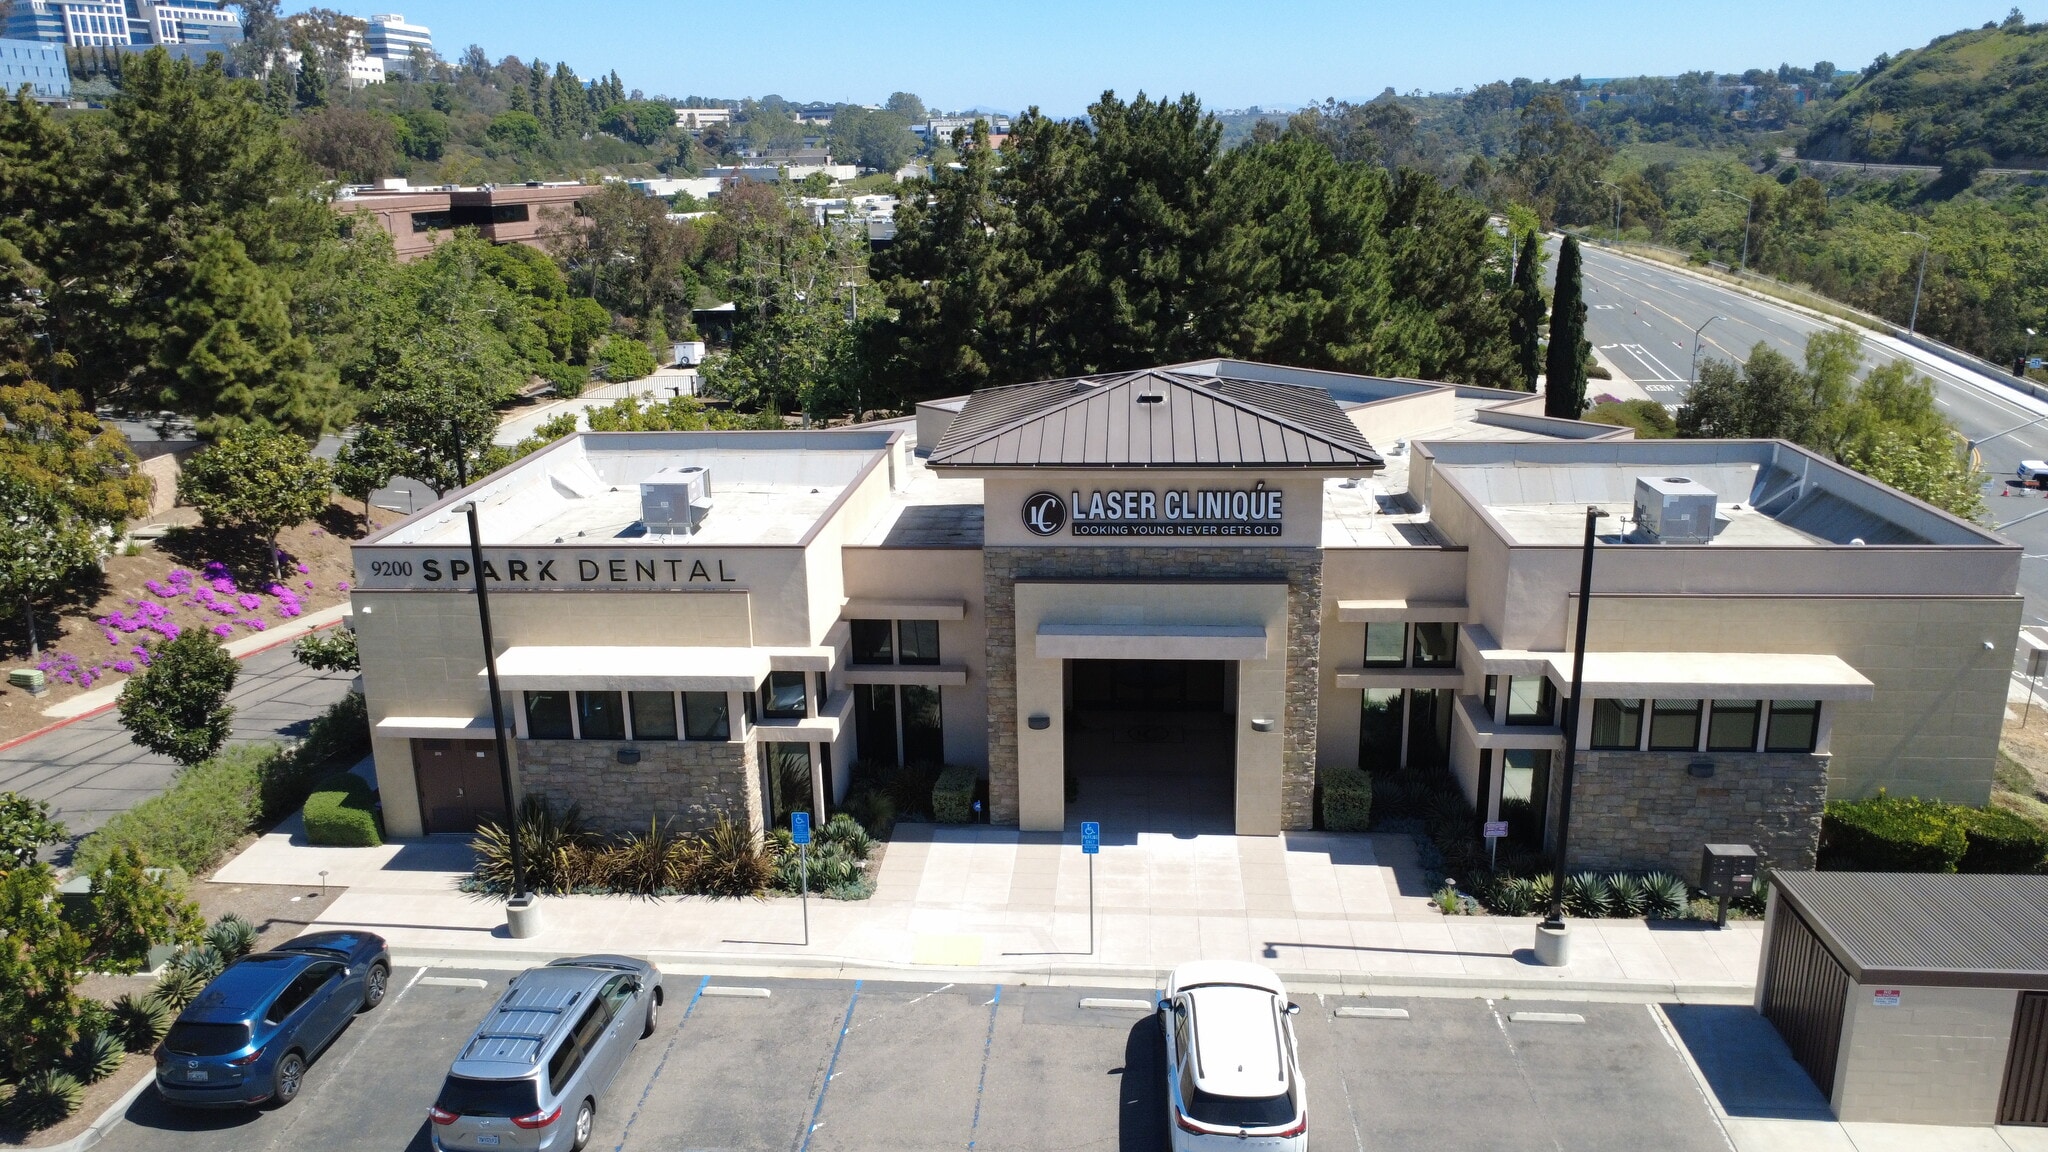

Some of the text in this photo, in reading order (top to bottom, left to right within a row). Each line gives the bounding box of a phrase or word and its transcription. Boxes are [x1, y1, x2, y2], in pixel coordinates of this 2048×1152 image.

[1072, 490, 1157, 520] LASER
[1074, 525, 1279, 535] LOOKING YOUNG NEVER GETS OLD
[371, 559, 736, 582] 9200 SPARK DENTAL
